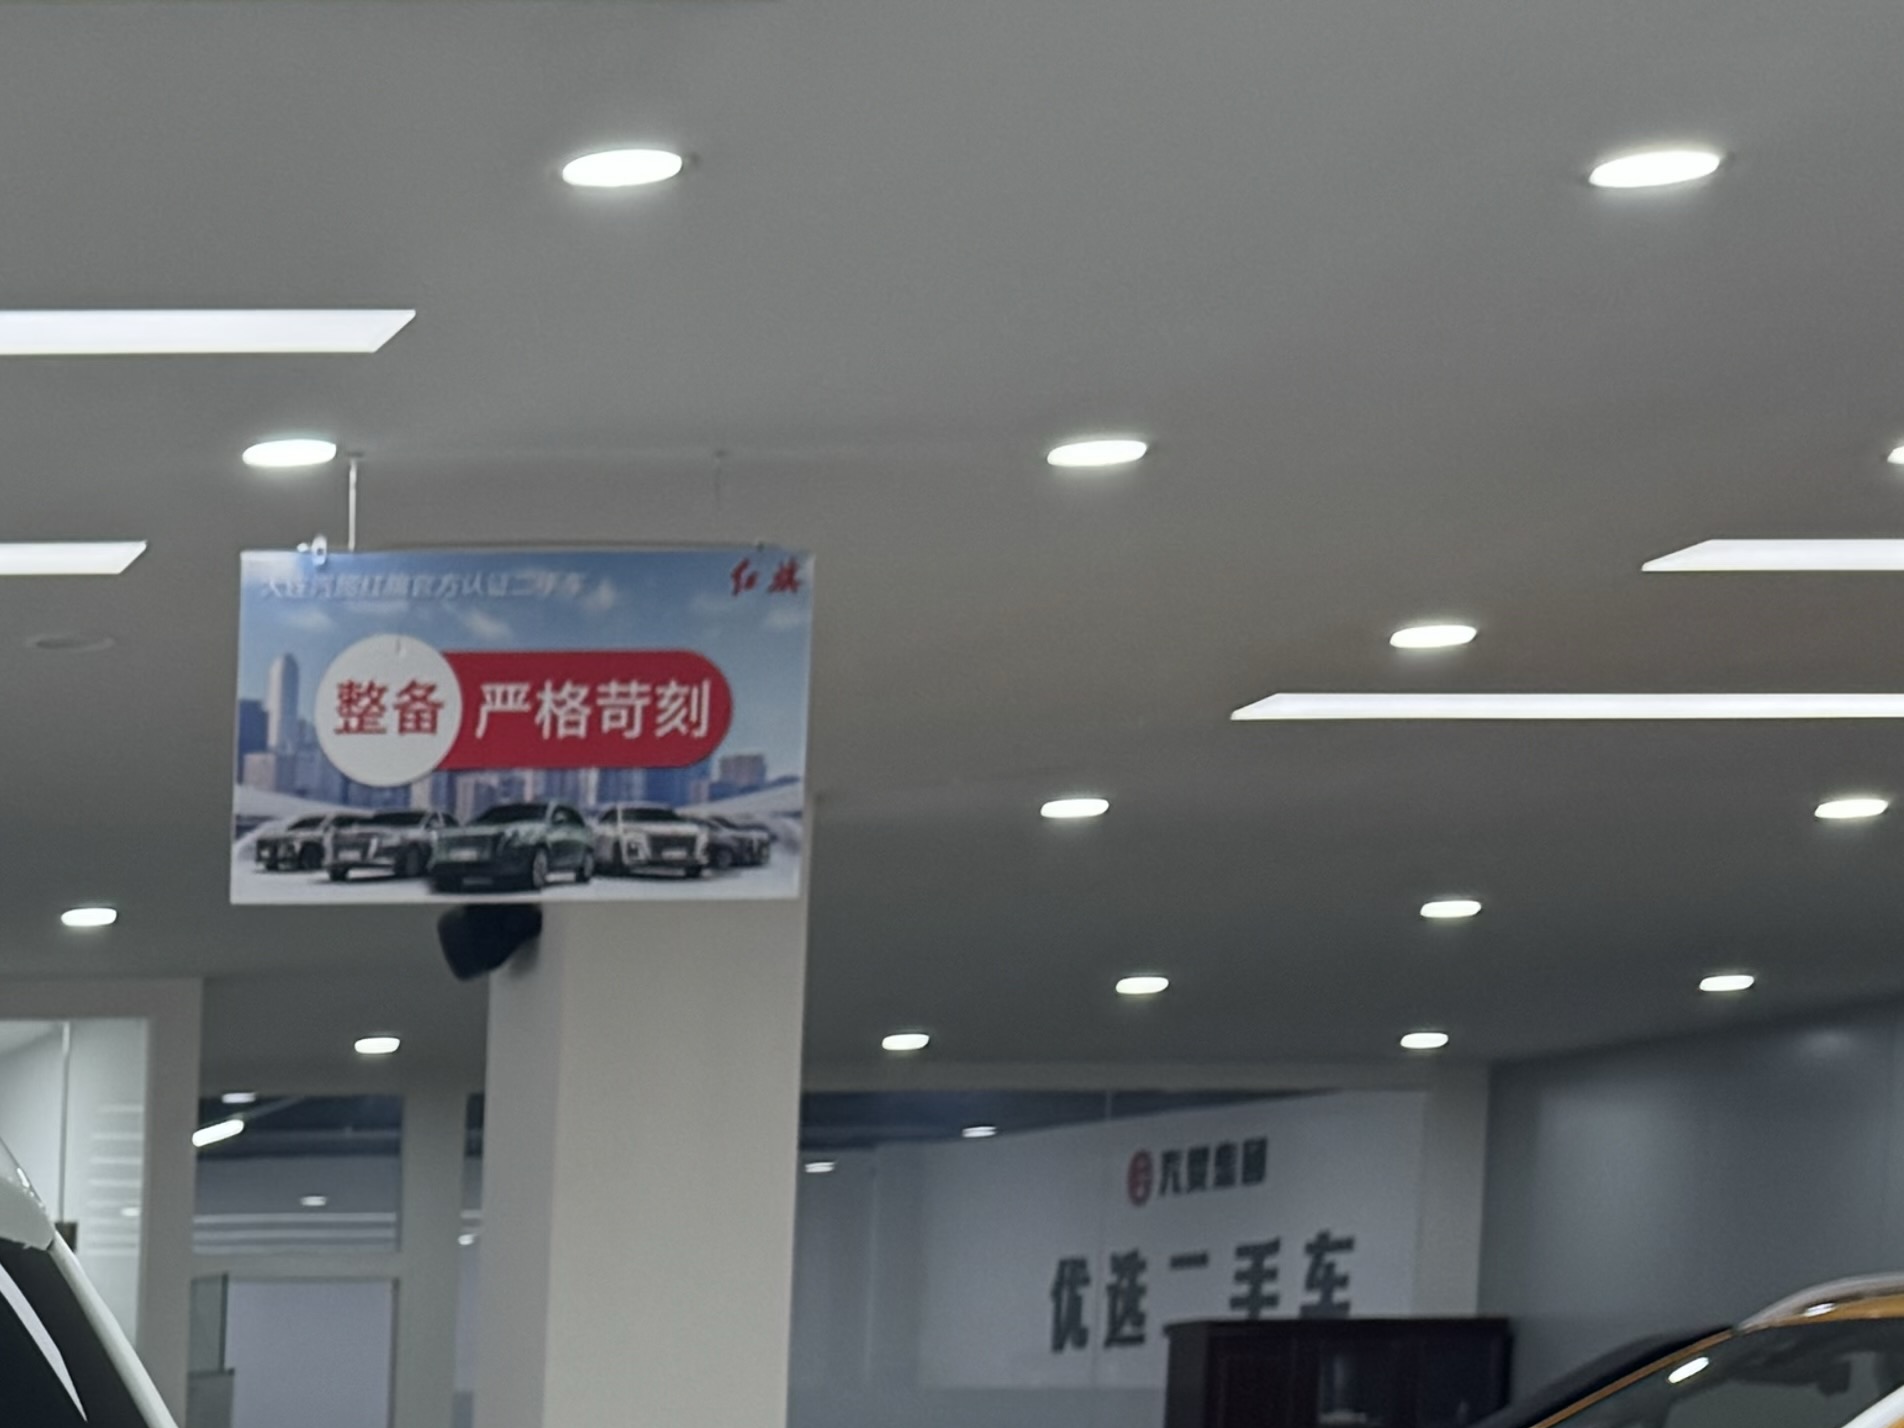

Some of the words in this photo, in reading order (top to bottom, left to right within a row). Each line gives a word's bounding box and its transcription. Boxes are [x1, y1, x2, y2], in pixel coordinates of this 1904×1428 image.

[334, 679, 445, 736] 整备
[476, 678, 710, 740] 严格苛刻
